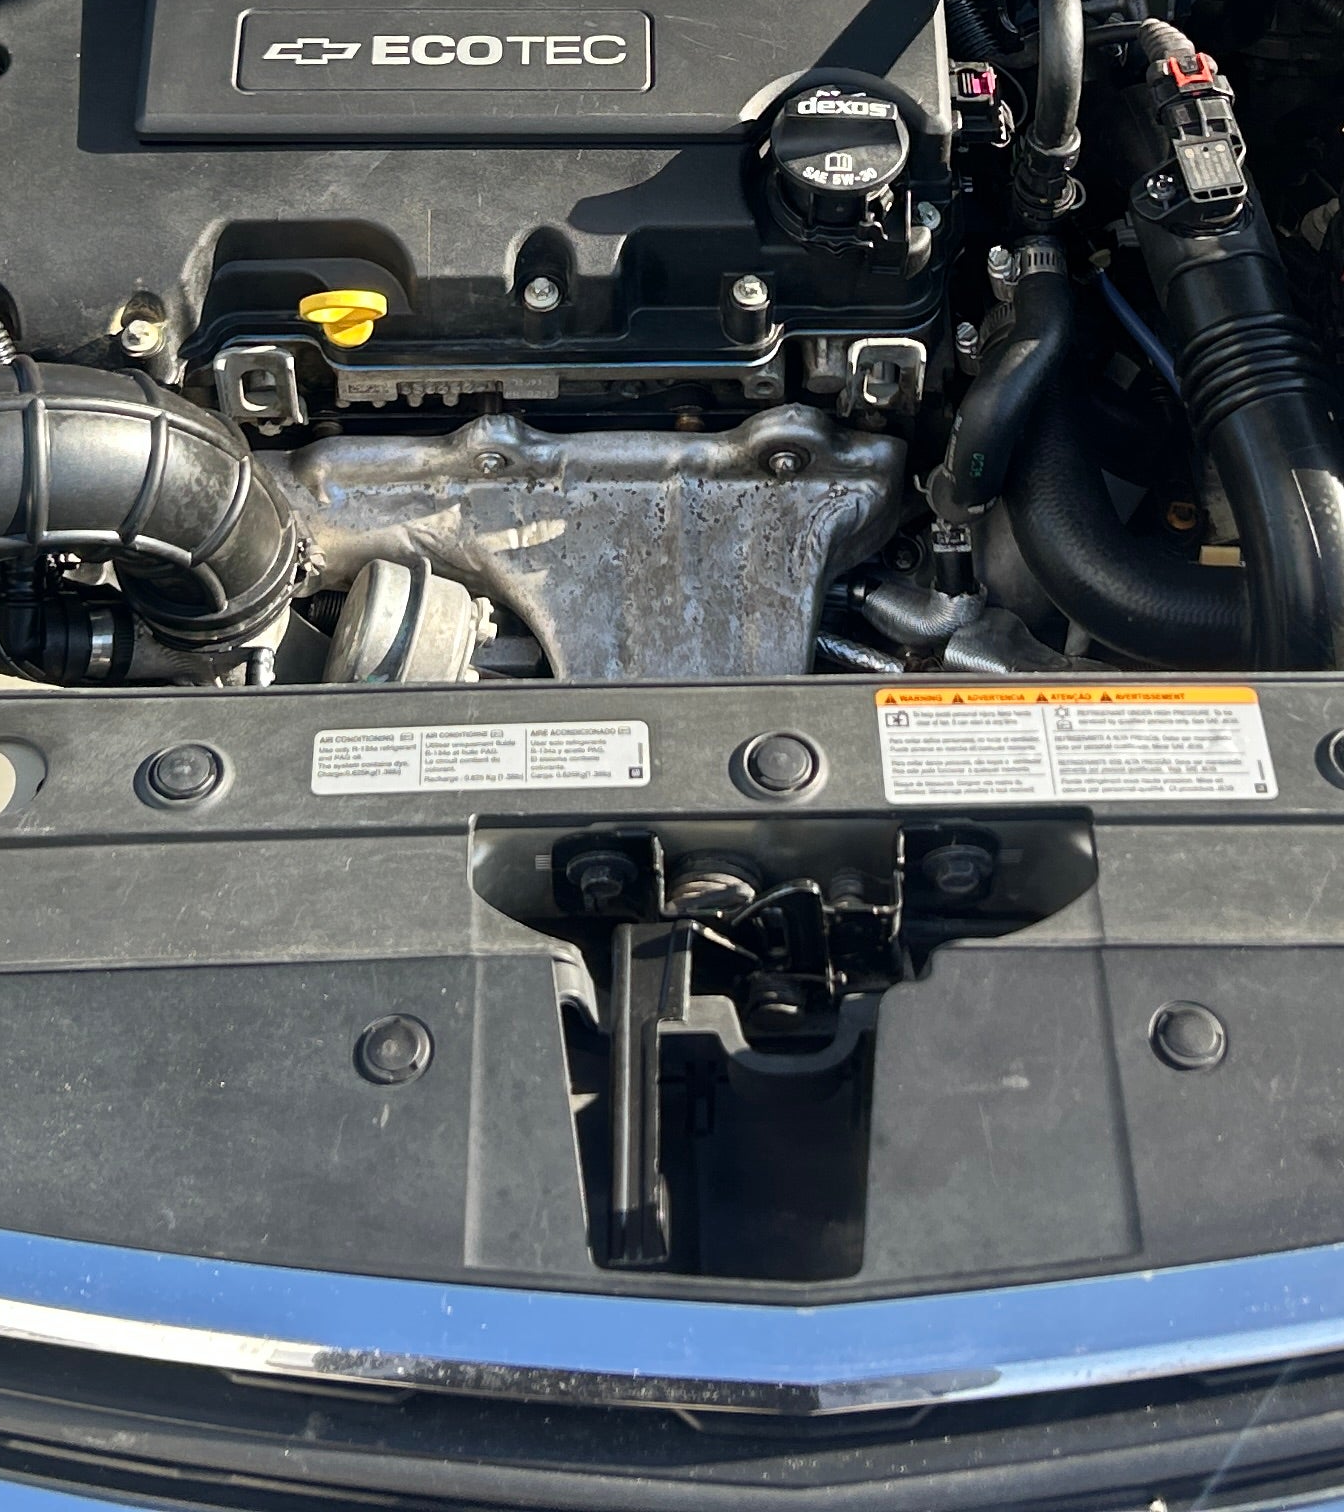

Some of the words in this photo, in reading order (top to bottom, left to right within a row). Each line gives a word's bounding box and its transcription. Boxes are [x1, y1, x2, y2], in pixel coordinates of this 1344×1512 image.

[372, 35, 627, 66] ECOTEC
[798, 96, 889, 117] dexos
[802, 166, 829, 185] SAE
[832, 168, 878, 186] 5W-30
[899, 694, 943, 702] WARNING
[967, 694, 1025, 702] ADVERTENCIA
[1116, 692, 1185, 700] AVERTISSEMENT
[320, 736, 334, 744] AIR
[335, 734, 394, 743] CONDITIONING
